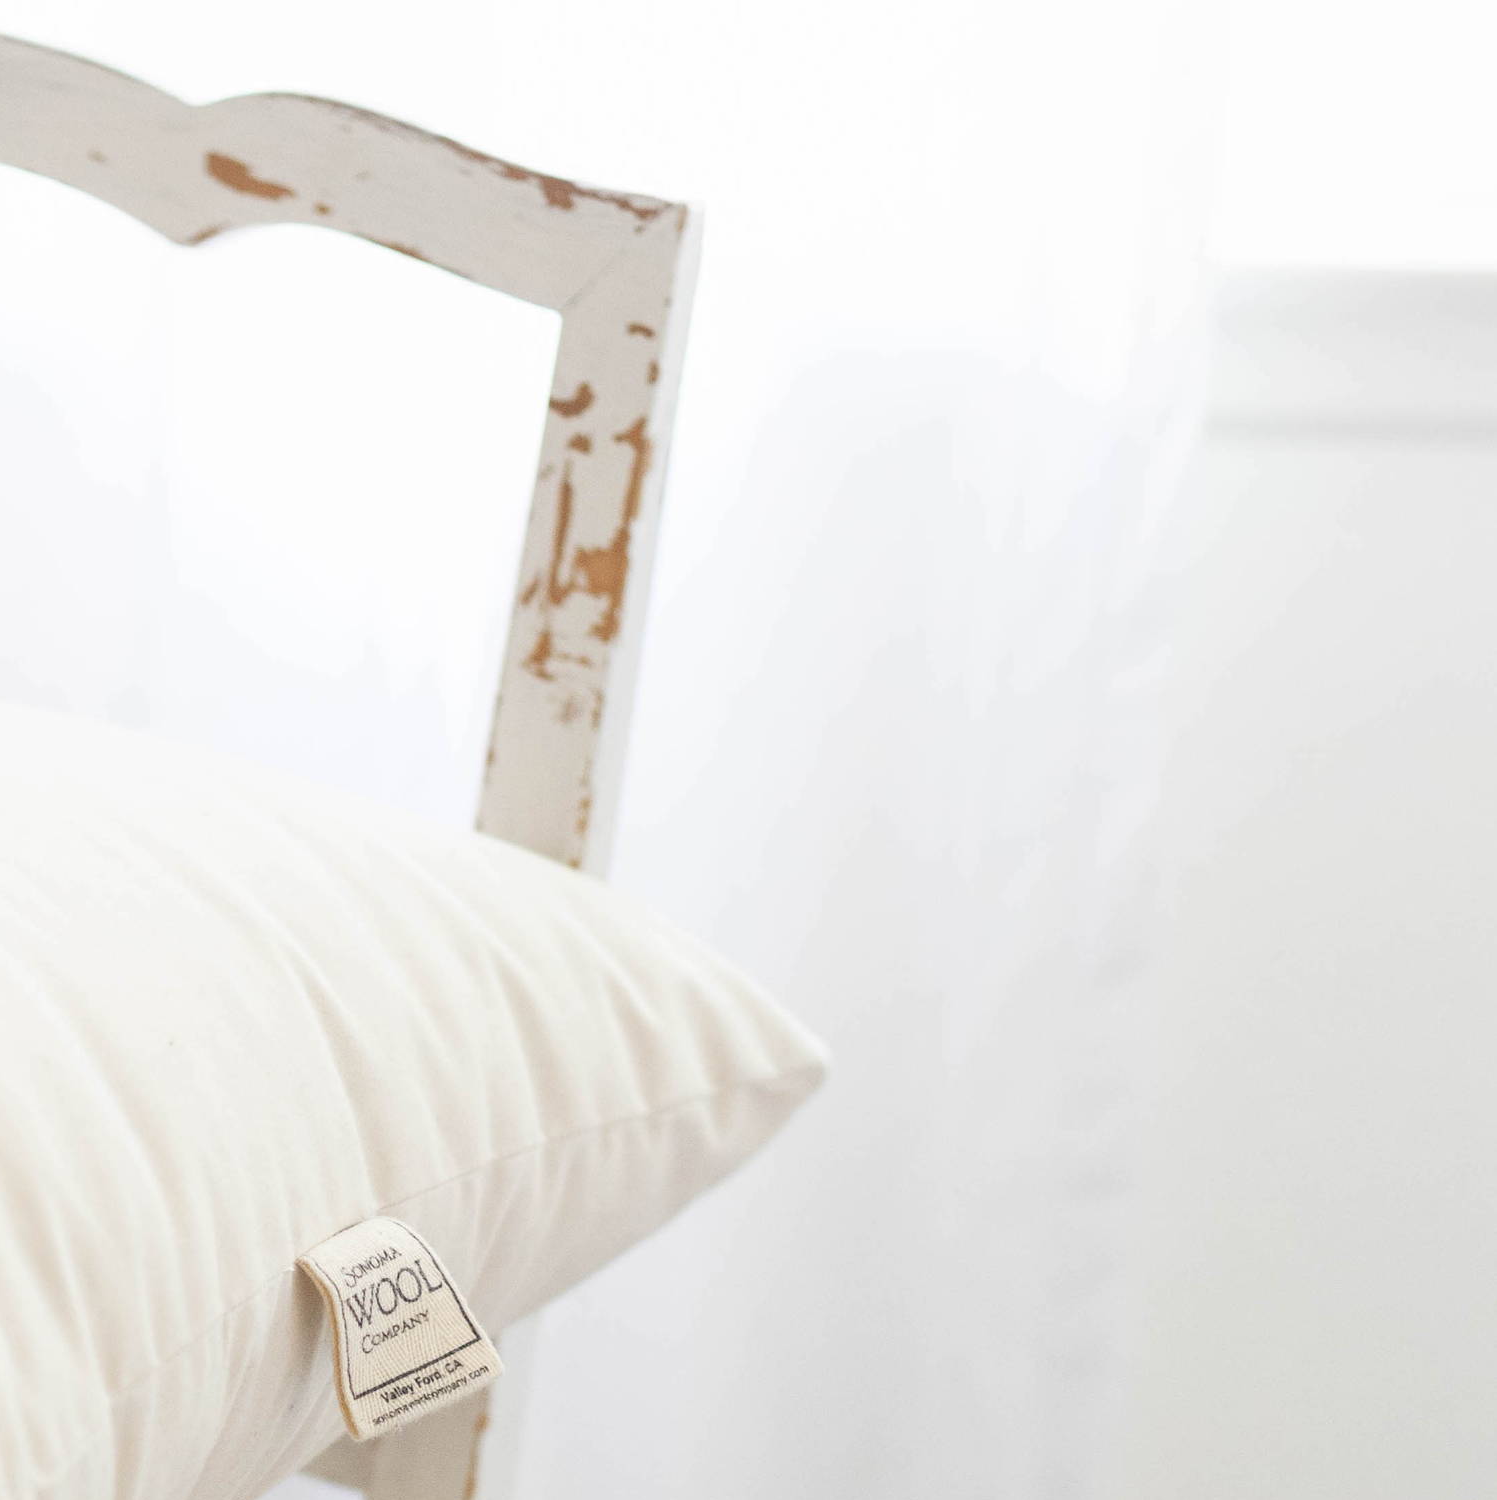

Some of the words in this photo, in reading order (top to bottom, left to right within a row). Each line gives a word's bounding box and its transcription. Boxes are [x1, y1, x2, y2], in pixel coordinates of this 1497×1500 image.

[341, 1246, 402, 1288] SONOMA
[345, 1258, 443, 1329] WOOL
[361, 1309, 429, 1354] COMPANY
[379, 1384, 414, 1404] Valley
[445, 1359, 464, 1374] CA
